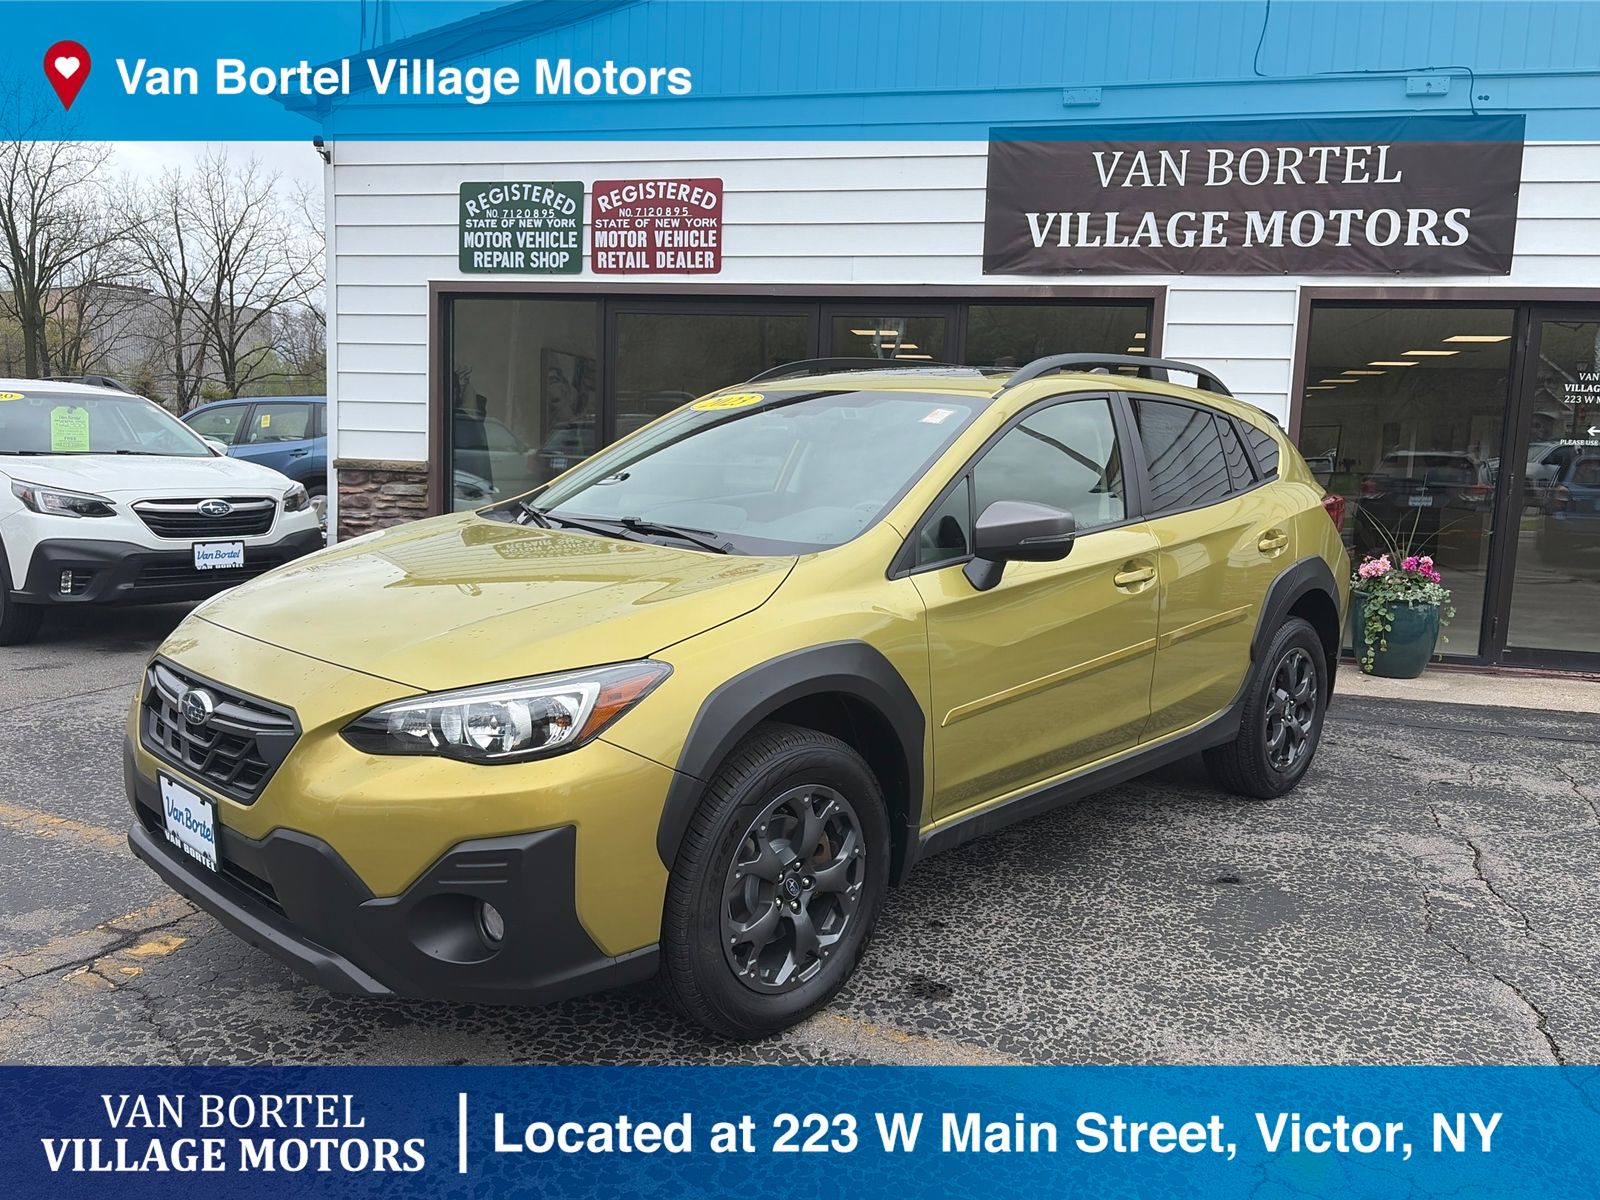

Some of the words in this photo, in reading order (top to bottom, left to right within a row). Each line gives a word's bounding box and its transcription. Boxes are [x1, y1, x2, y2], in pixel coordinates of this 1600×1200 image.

[1092, 150, 1190, 188] VAN
[1205, 146, 1402, 186] BORTEL
[465, 184, 576, 217] REGISTERED
[597, 182, 717, 213] REGISTERED
[502, 209, 555, 218] 7120895
[619, 208, 633, 217] NO.
[635, 207, 689, 216] 7120895
[465, 219, 497, 228] STATE
[501, 219, 515, 228] OF
[519, 219, 542, 228] NEW
[546, 219, 576, 228] YORK
[595, 219, 630, 228] STATE
[635, 219, 650, 228] OF
[655, 219, 680, 228] NEW
[685, 218, 717, 228] YORK
[1025, 211, 1230, 248] VILLAGE
[1242, 207, 1471, 247] MOTORS
[464, 231, 512, 248] MOTOR
[516, 231, 578, 248] VEHICLE
[595, 231, 647, 248] MOTOR
[654, 230, 717, 247] VEHICLE
[473, 251, 525, 268] REPAIR
[530, 251, 570, 268] SHOP
[597, 251, 649, 268] RETAIL
[656, 251, 714, 268] DEALER
[1579, 372, 1600, 381] VAN
[1564, 395, 1582, 405] 223
[1584, 395, 1595, 404] W
[197, 550, 213, 560] Van
[215, 549, 241, 559] Bortel
[166, 796, 184, 826] Van
[185, 808, 213, 844] Bortel
[164, 830, 181, 848] VAN
[183, 842, 216, 873] BORTEL
